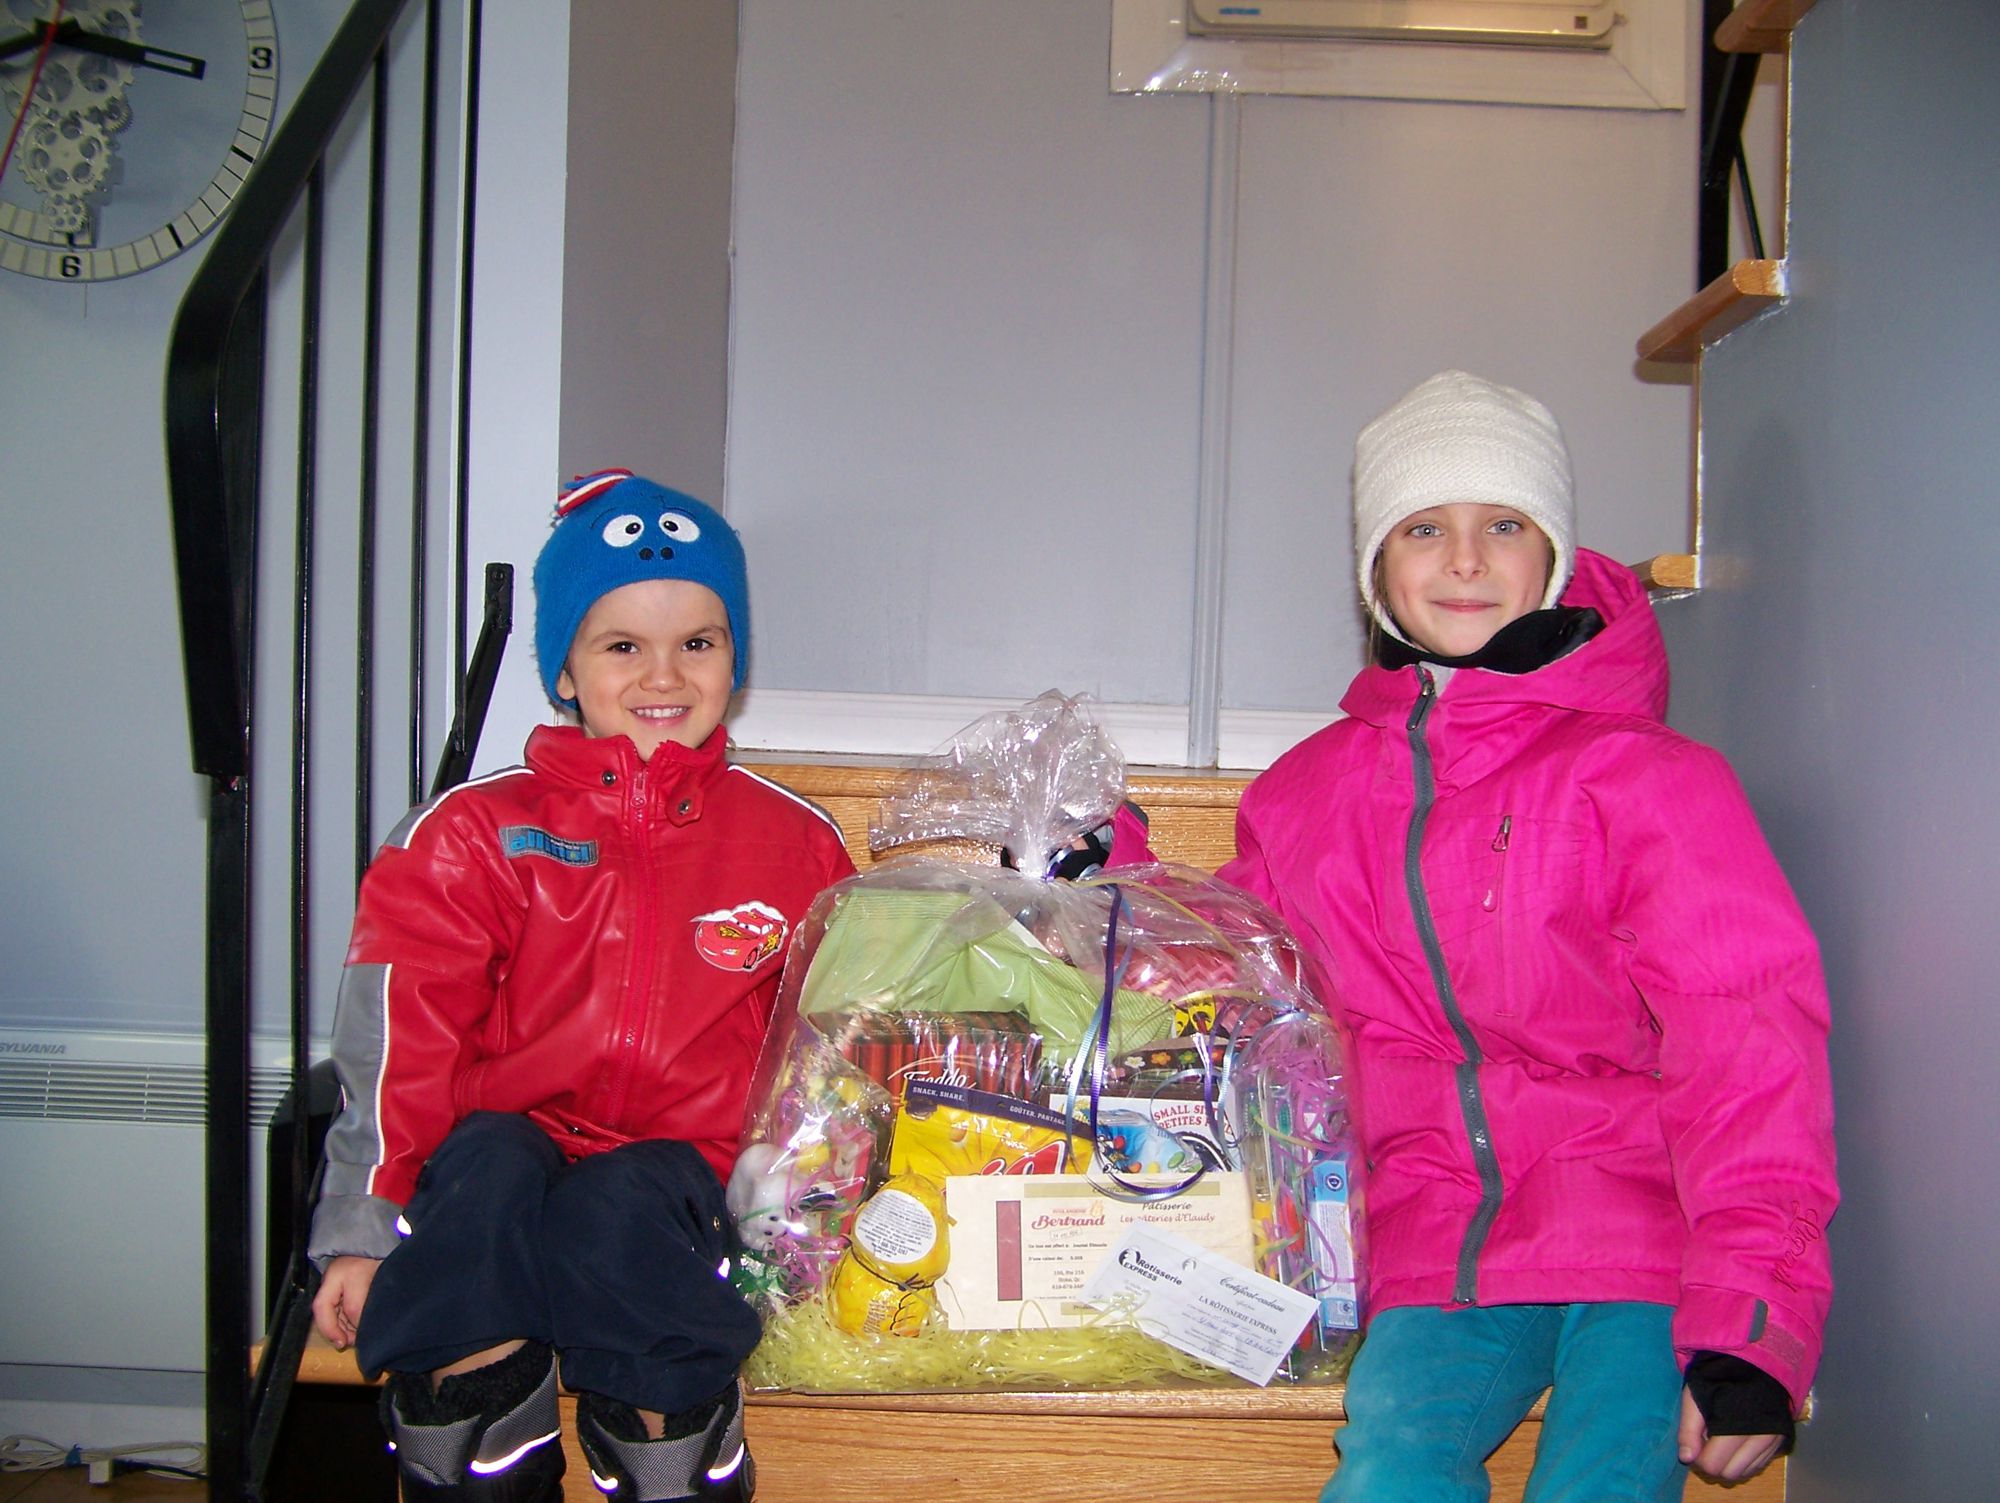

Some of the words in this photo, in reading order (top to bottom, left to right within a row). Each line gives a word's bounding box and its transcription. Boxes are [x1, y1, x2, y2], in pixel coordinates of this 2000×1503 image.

[252, 47, 273, 70] 3
[60, 256, 81, 279] 6
[0, 1042, 66, 1054] SYLVANIA
[904, 1067, 967, 1089] Fddo
[912, 1086, 938, 1097] SNACK.
[940, 1091, 965, 1102] SHARE.
[1037, 1112, 1067, 1126] PARTAGE
[1154, 1104, 1191, 1121] SMALL
[1158, 1115, 1202, 1129] PETITES
[1031, 1214, 1105, 1230] Bertrand
[1123, 1262, 1158, 1282] EXPRESS
[1138, 1259, 1183, 1286] Rotisserie
[1198, 1295, 1209, 1305] LA
[1248, 1317, 1278, 1336] EXPRESS
